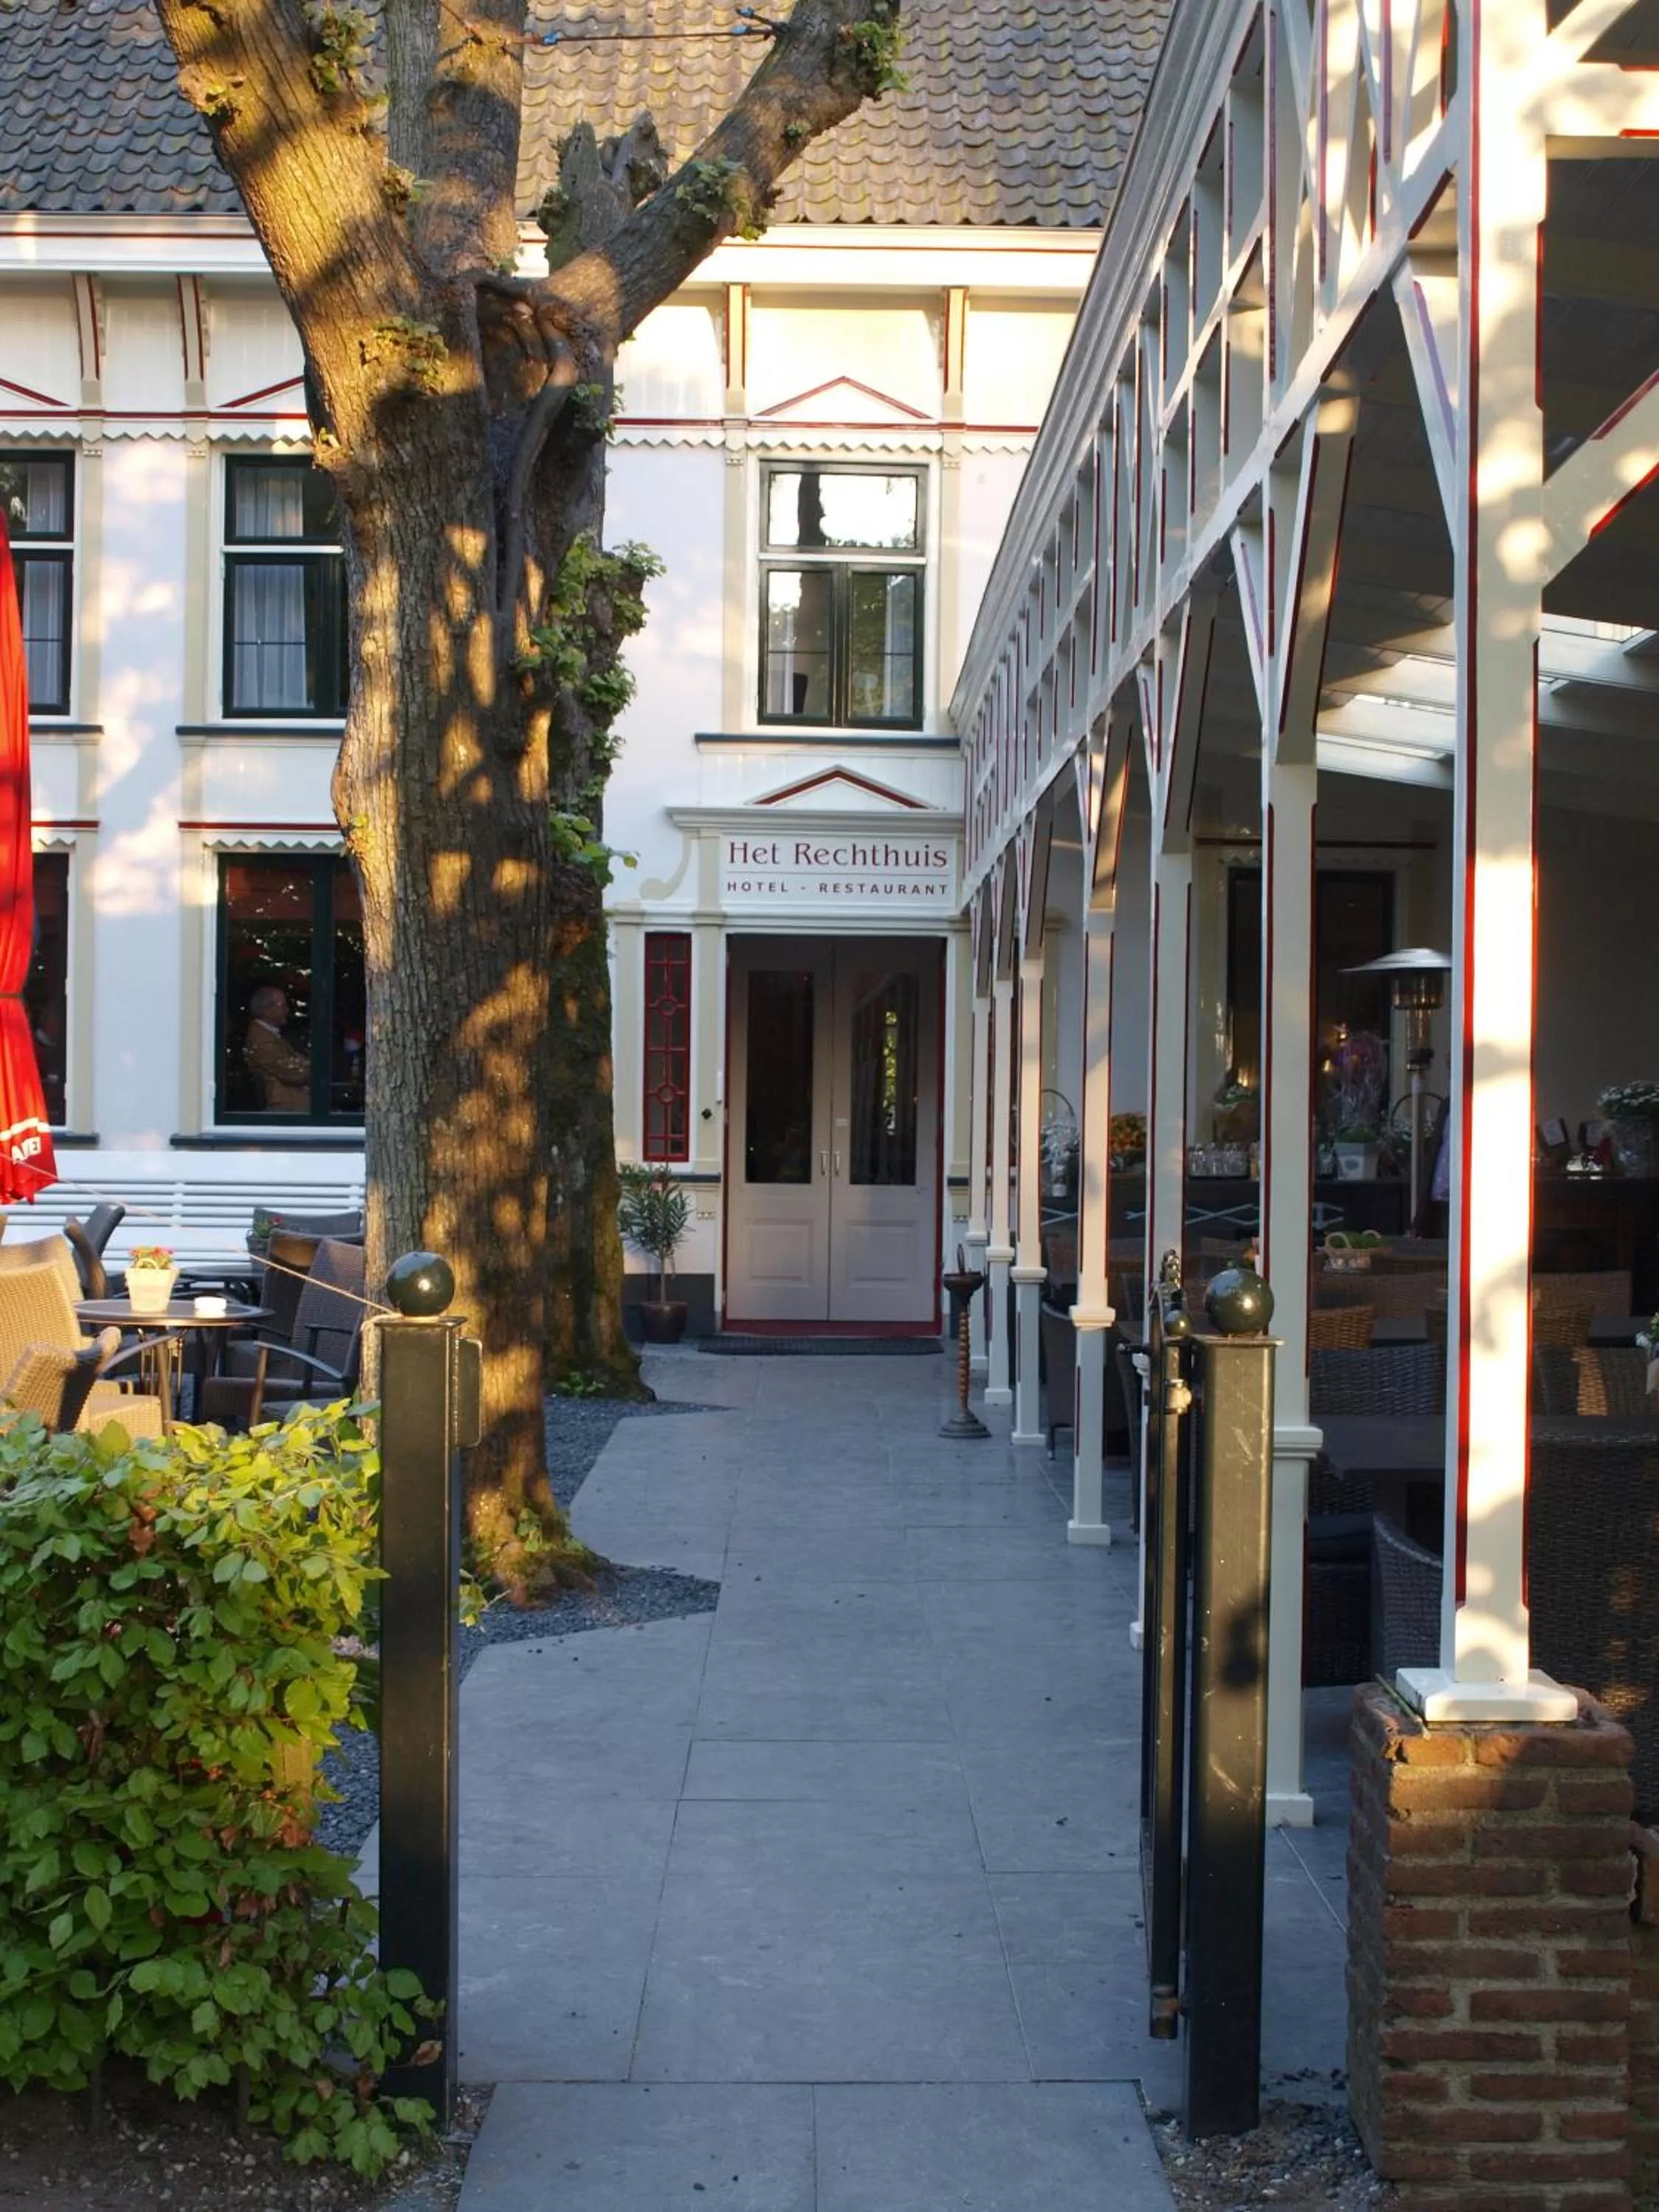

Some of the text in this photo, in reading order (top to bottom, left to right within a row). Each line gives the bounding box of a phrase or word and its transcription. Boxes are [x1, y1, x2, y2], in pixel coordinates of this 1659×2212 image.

[728, 842, 948, 868] Het Rechthuis
[727, 882, 788, 893] HOTEL
[818, 883, 948, 895] RESTAURANT
